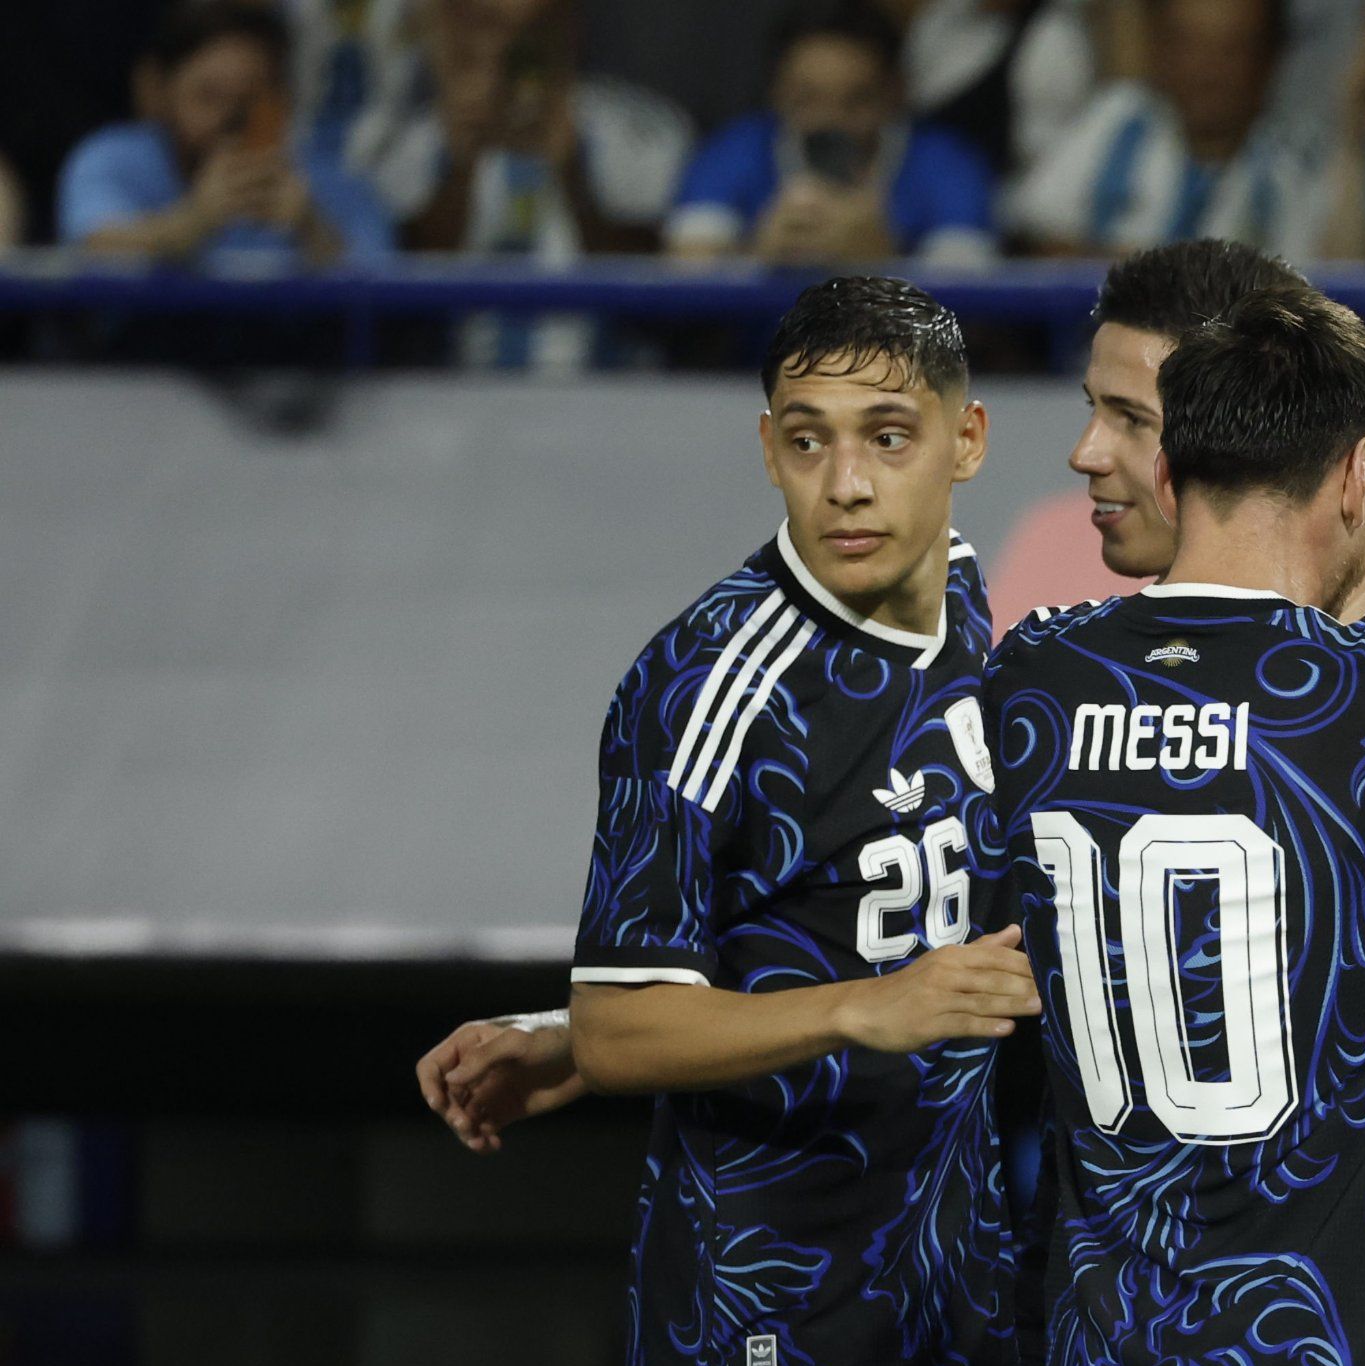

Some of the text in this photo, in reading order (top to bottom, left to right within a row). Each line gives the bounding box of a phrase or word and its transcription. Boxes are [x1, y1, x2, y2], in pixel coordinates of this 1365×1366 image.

[1149, 646, 1198, 660] ARGENTINA
[1068, 702, 1250, 771] MESSI
[856, 815, 970, 963] 26
[1029, 811, 1300, 1147] 10
